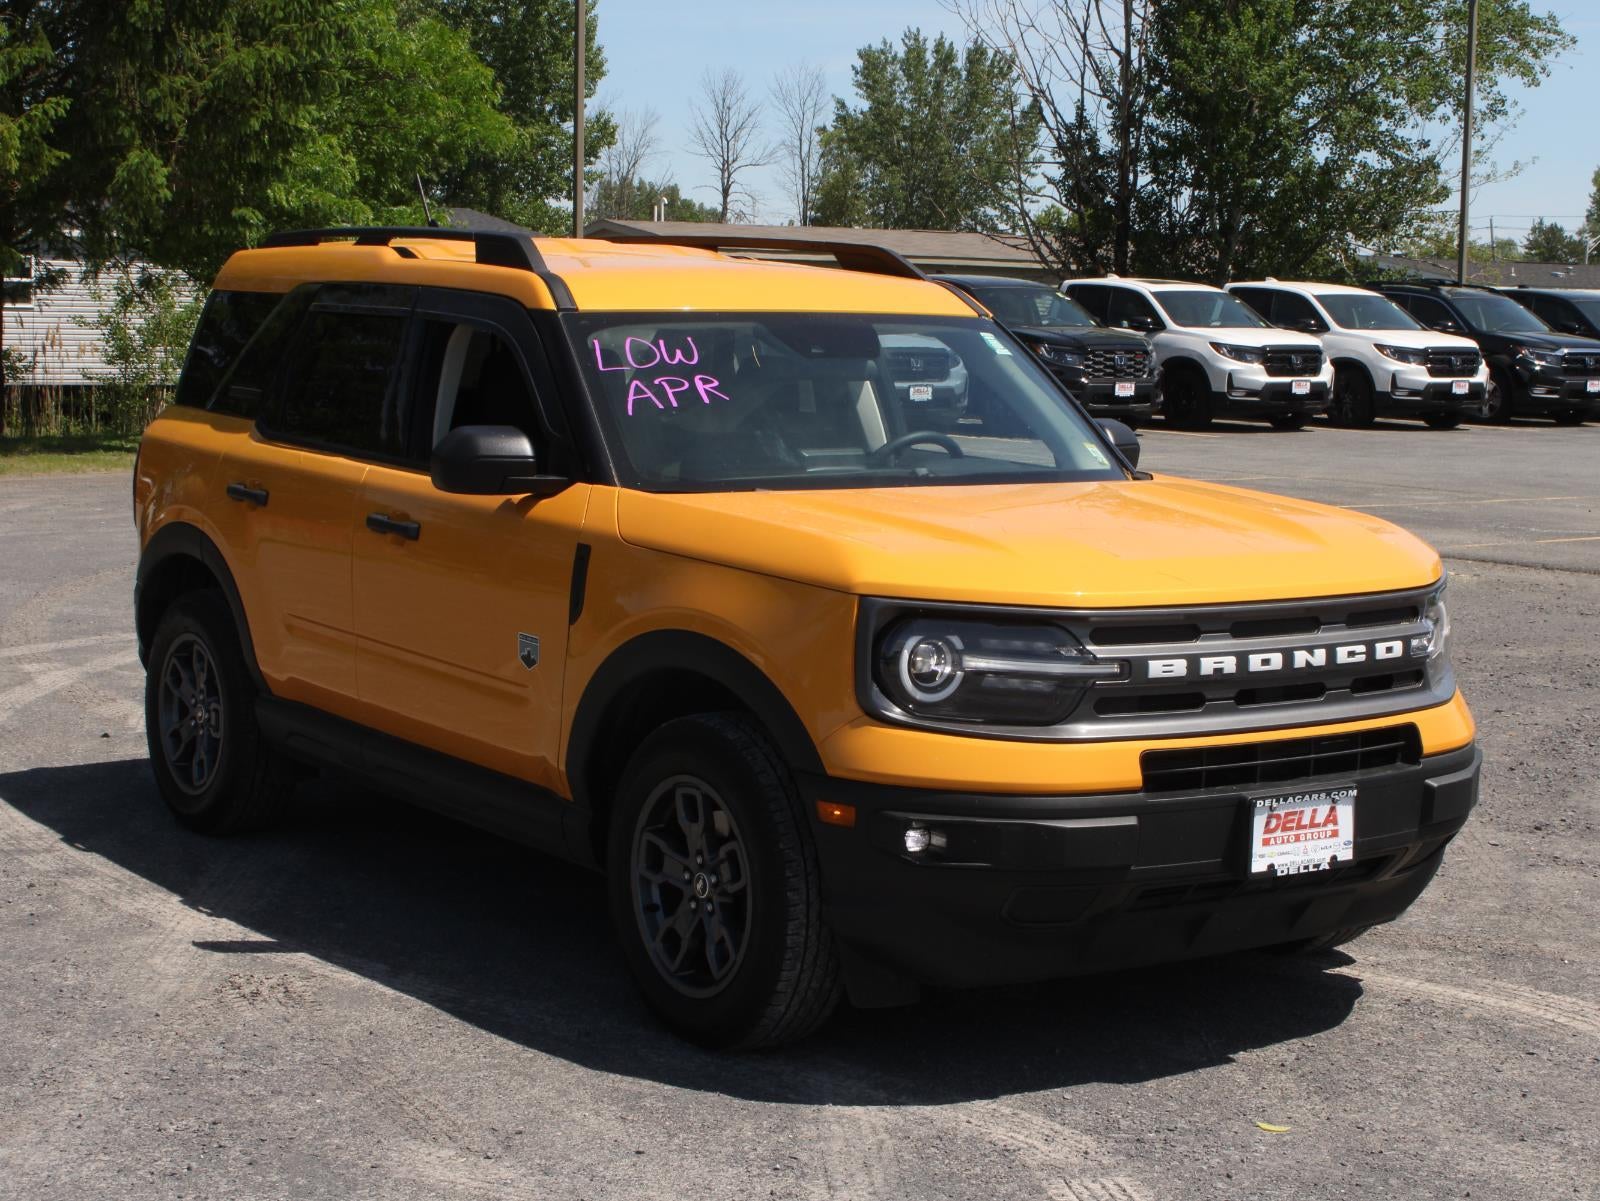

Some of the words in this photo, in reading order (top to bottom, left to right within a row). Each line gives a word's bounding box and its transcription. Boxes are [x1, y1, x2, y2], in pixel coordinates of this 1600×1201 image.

[593, 336, 698, 371] LOW
[628, 374, 730, 416] APR
[1148, 640, 1403, 678] BRONCO
[1256, 789, 1358, 807] DELLACARS.COM
[1263, 806, 1339, 835] DELLA
[1269, 835, 1295, 845] AUTO
[1300, 831, 1332, 841] GROUP
[1277, 863, 1330, 876] DELLA
